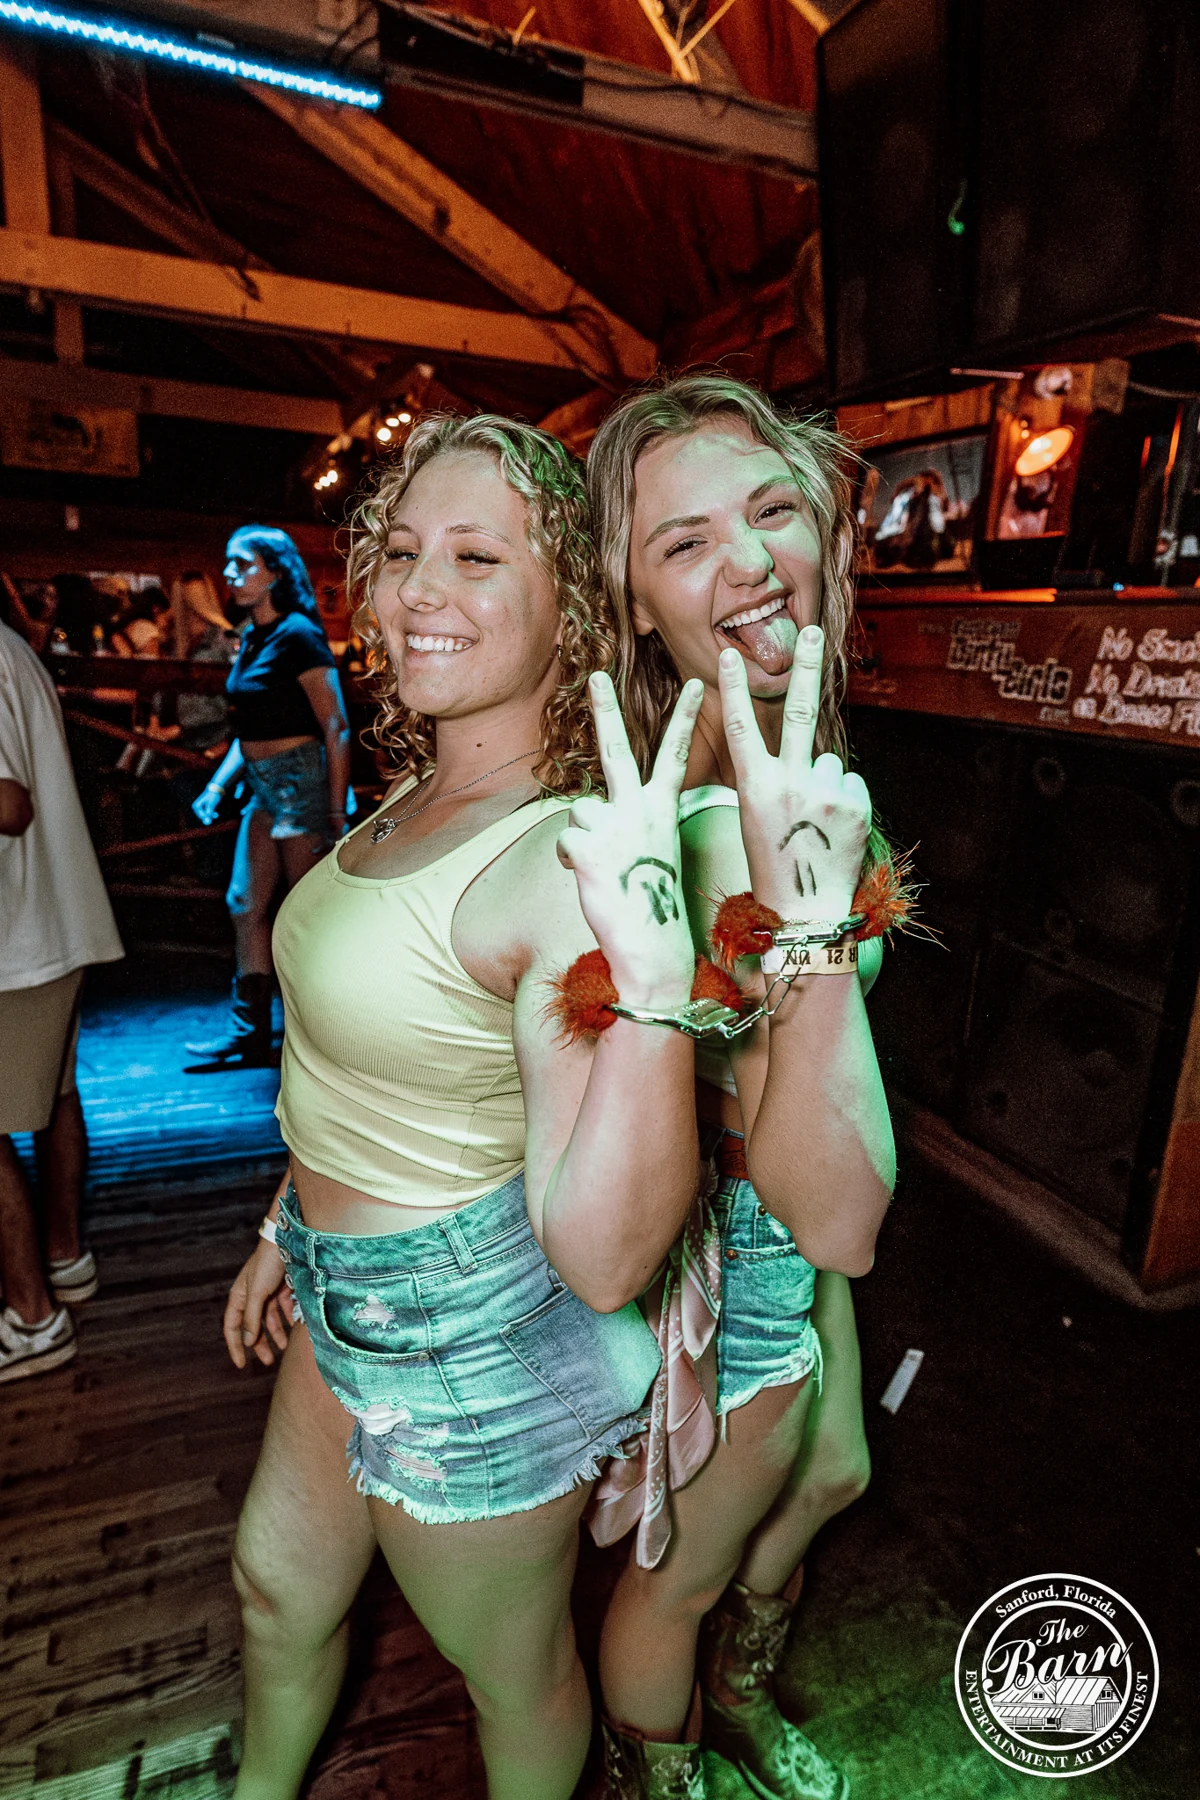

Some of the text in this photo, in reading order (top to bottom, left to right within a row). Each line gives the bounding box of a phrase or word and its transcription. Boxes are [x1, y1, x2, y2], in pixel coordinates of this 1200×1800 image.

[1096, 625, 1134, 661] No
[1083, 662, 1120, 695] No
[826, 948, 845, 965] 21
